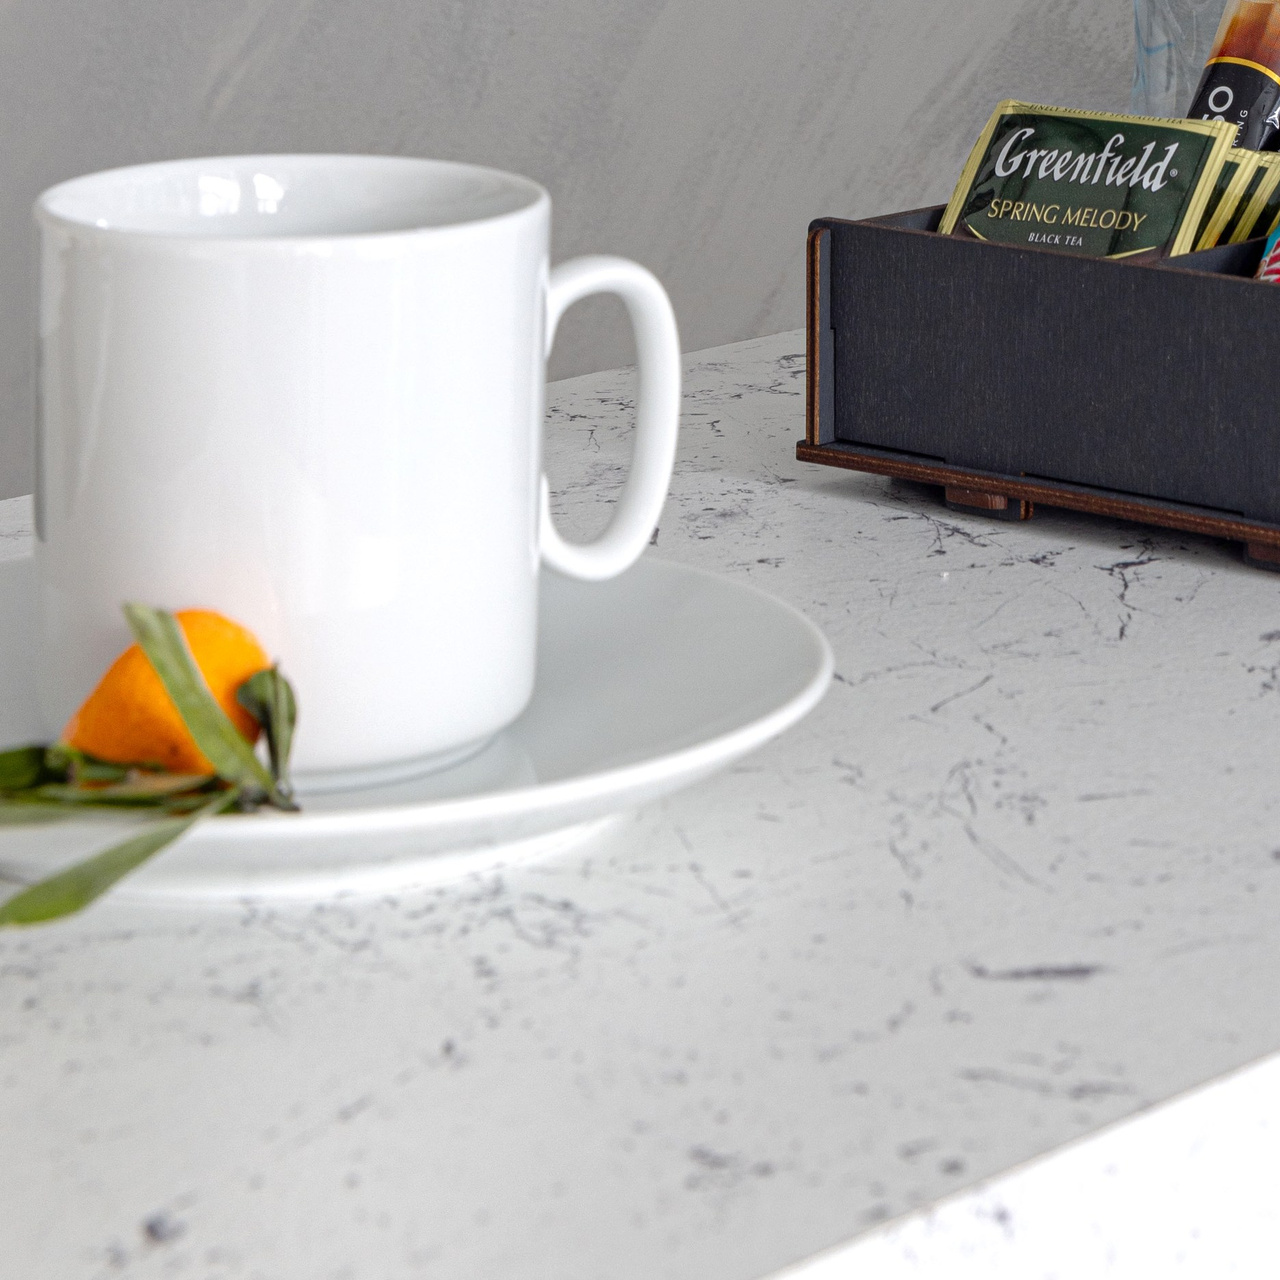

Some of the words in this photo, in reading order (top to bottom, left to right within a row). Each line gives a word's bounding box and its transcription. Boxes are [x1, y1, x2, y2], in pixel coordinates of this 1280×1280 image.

[1029, 104, 1059, 112] FINELY
[1063, 107, 1107, 116] SELECTED
[995, 128, 1179, 192] Greenfield
[987, 199, 1060, 224] SPRING
[1061, 206, 1148, 232] MELODY
[1028, 232, 1061, 245] BLACK
[1065, 235, 1083, 247] TEA
